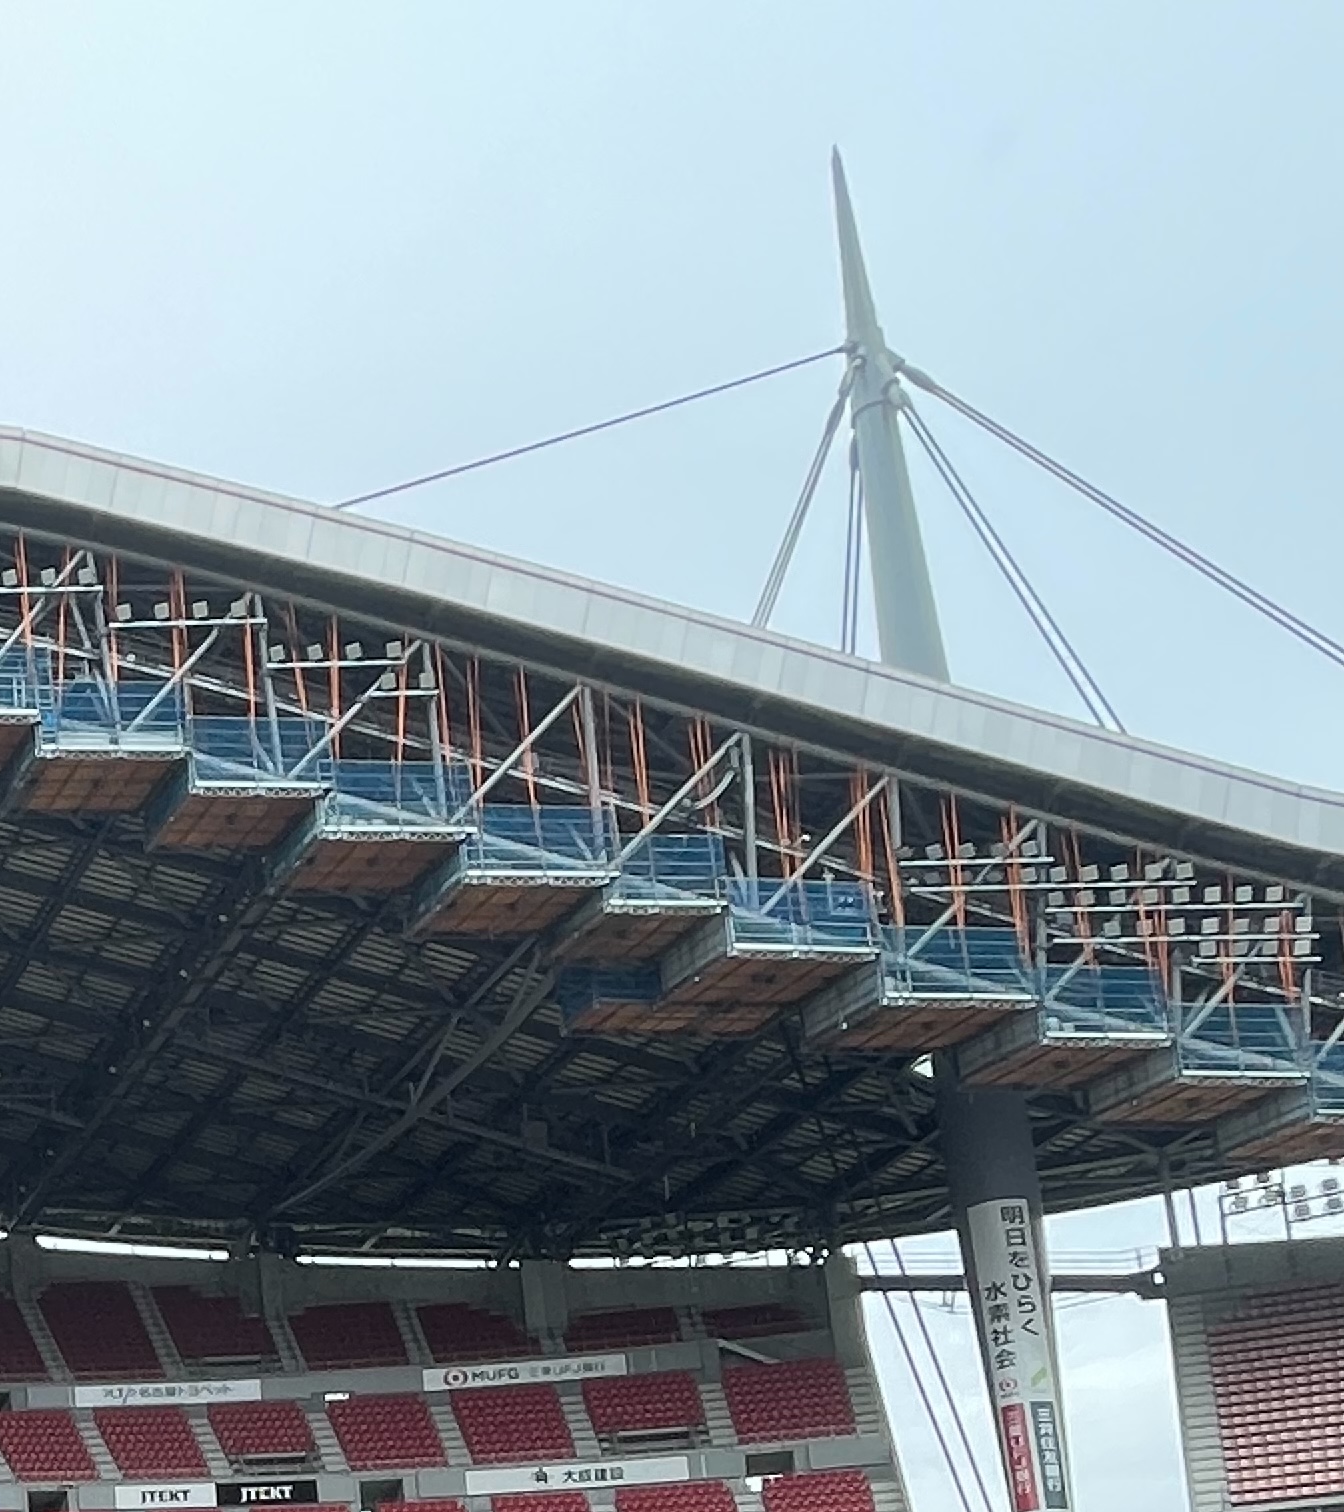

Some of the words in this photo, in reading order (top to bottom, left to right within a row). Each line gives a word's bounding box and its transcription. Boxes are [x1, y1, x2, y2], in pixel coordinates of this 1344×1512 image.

[1000, 1205, 1040, 1336] 明日をひらく
